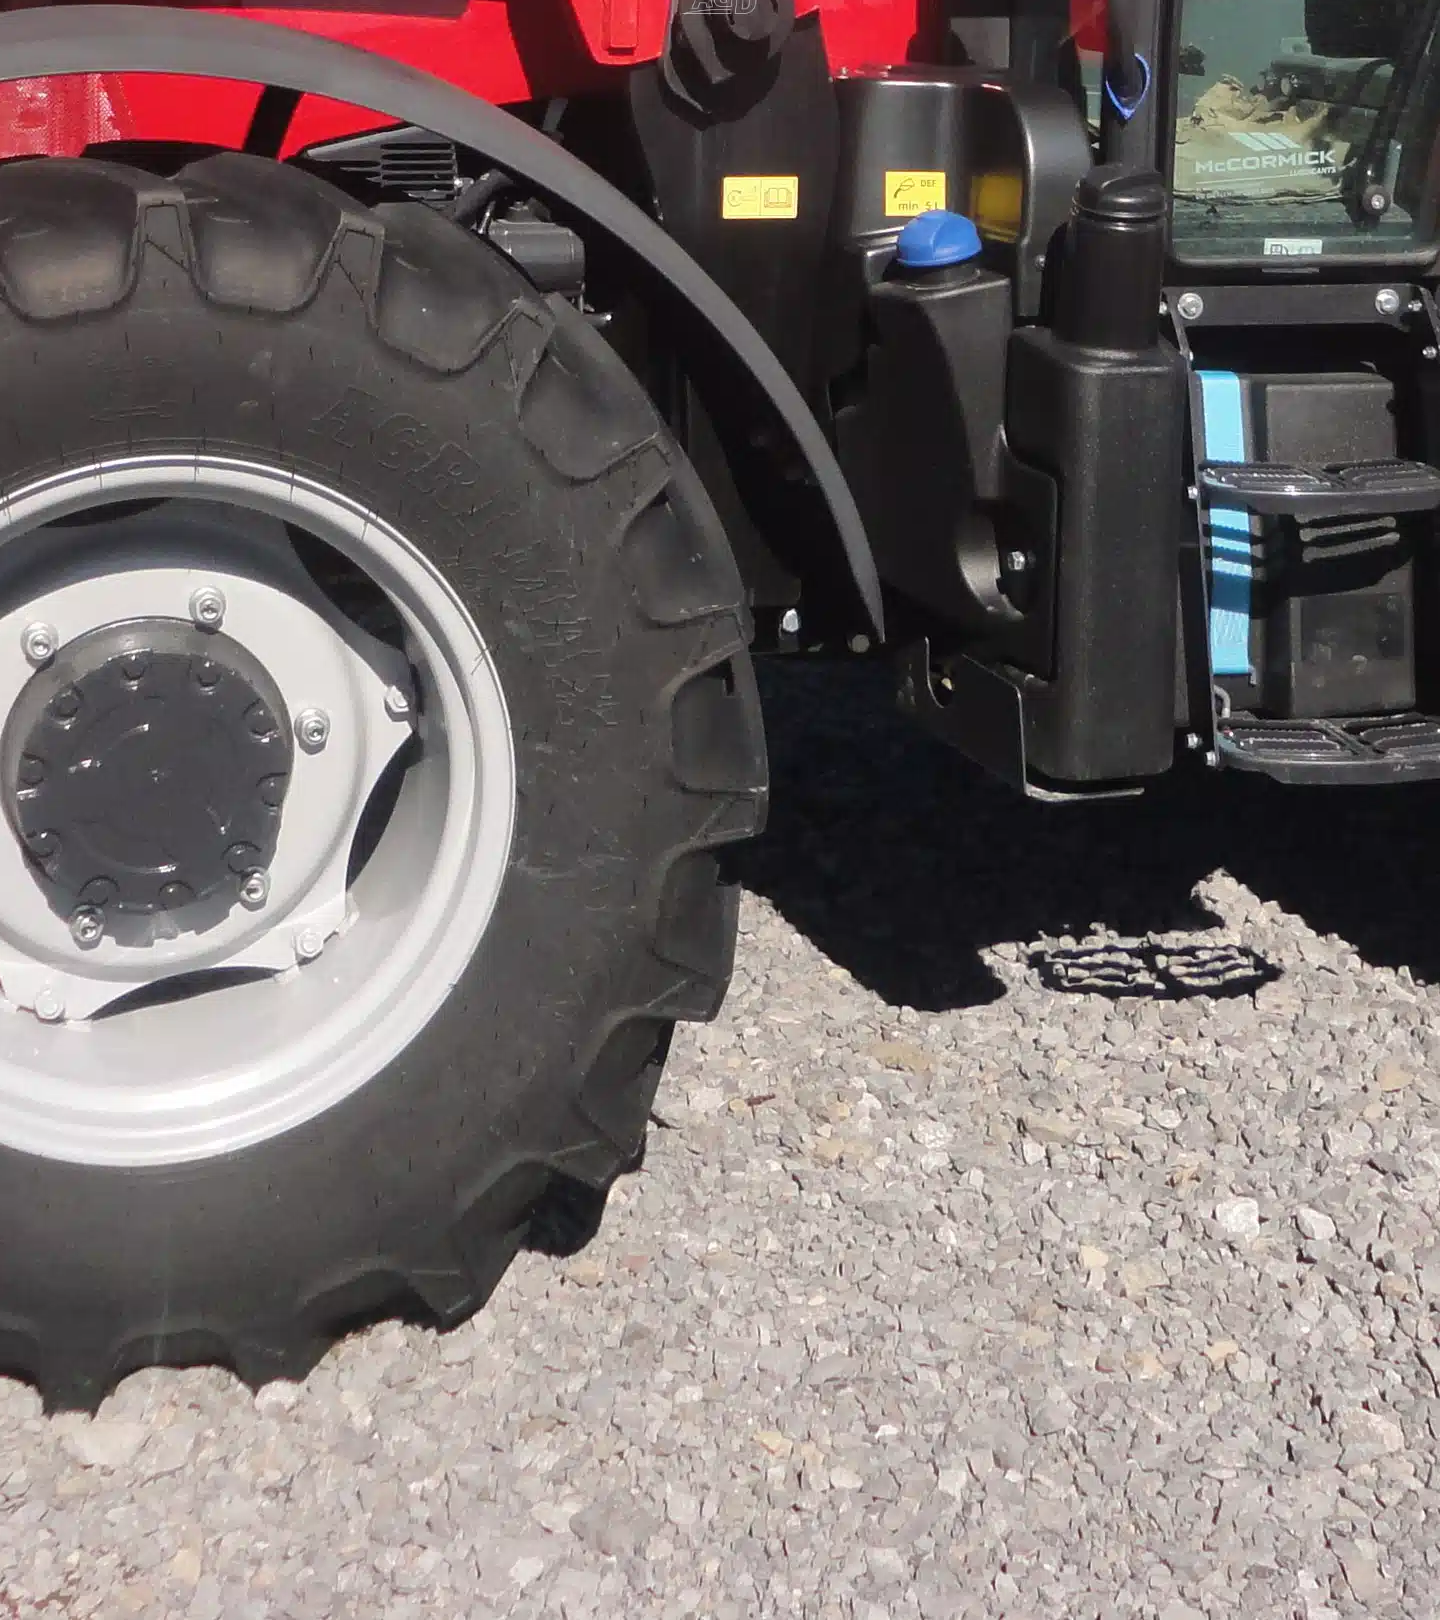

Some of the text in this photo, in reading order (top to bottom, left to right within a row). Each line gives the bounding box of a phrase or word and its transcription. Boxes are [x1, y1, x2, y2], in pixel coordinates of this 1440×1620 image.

[1194, 149, 1337, 175] McCORMICK
[920, 179, 937, 188] DEF
[898, 201, 919, 211] min
